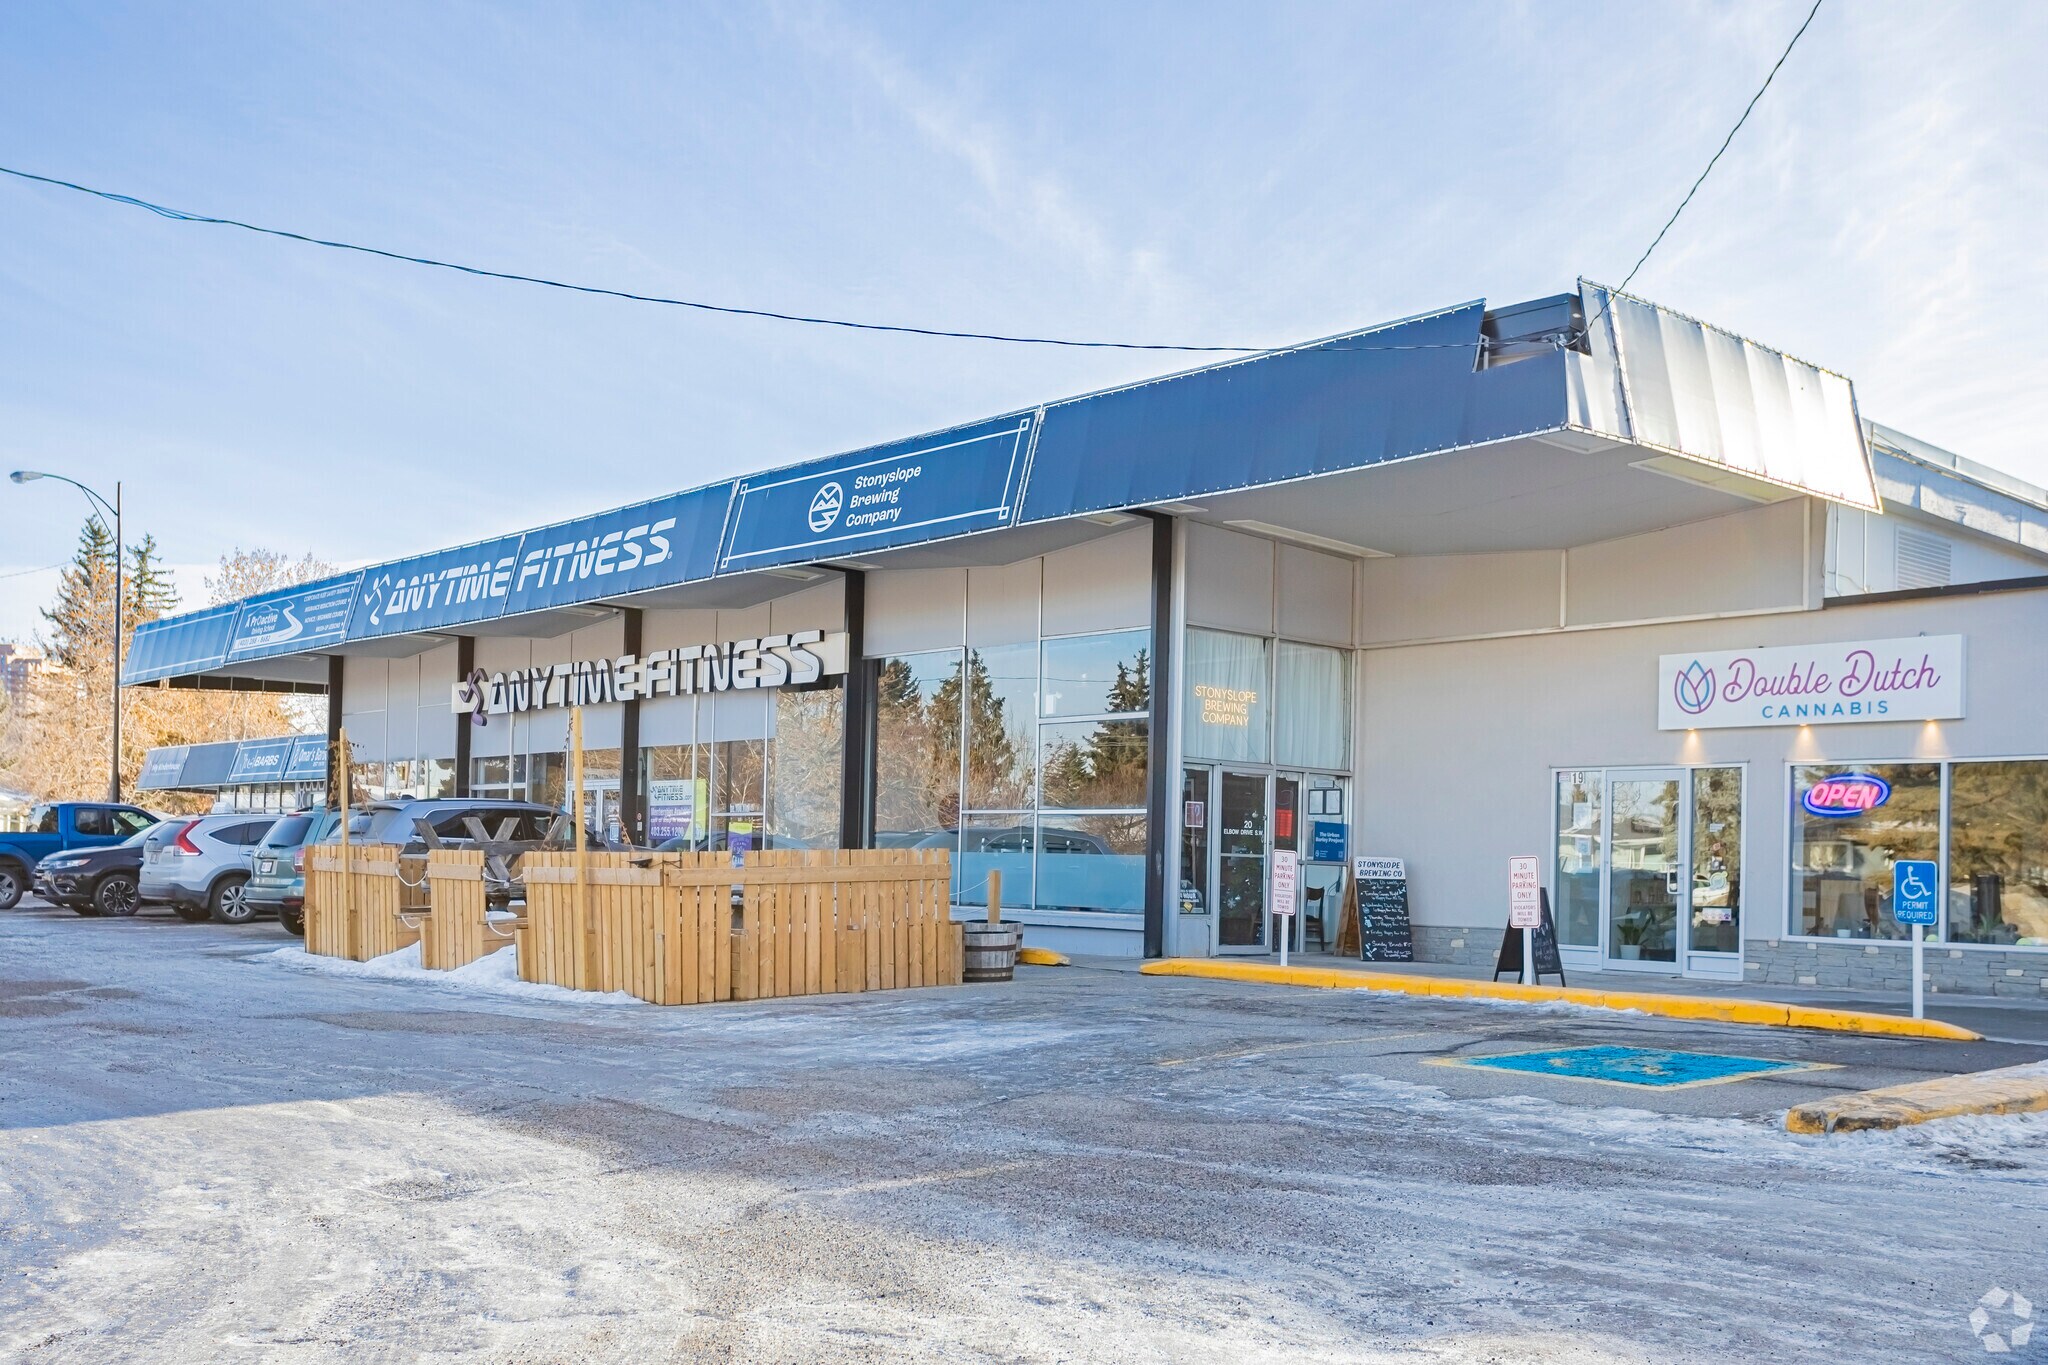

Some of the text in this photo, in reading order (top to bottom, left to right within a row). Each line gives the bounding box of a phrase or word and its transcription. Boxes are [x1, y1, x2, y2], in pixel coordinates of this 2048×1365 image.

[855, 466, 922, 489] Stonyslope
[850, 487, 900, 509] Brewing
[846, 507, 902, 527] Company
[385, 517, 676, 616] ANYTIME FITNESS
[251, 623, 276, 636] Driving School
[488, 629, 825, 714] ANYTIME FITNESS
[1722, 650, 1941, 703] Double Dutch
[1195, 685, 1257, 704] STONYSLOPE
[1204, 699, 1247, 715] BREWING
[1762, 700, 1888, 719] CANNABIS
[1202, 711, 1249, 727] COMPANY
[1572, 772, 1584, 784] 19
[656, 785, 683, 793] ANYTIME
[656, 793, 683, 801] FITNESS
[1809, 783, 1880, 809] OPEN
[1243, 820, 1253, 829] 20
[1276, 864, 1293, 872] MINUTE
[1358, 861, 1400, 869] STONYSLOPE
[1274, 872, 1294, 881] PARKING
[1359, 869, 1402, 878] BREWING CO
[1278, 881, 1290, 889] ONLY
[1517, 891, 1532, 899] ONLY
[1902, 901, 1928, 909] PERMIT
[1897, 911, 1933, 920] REQUIRED
